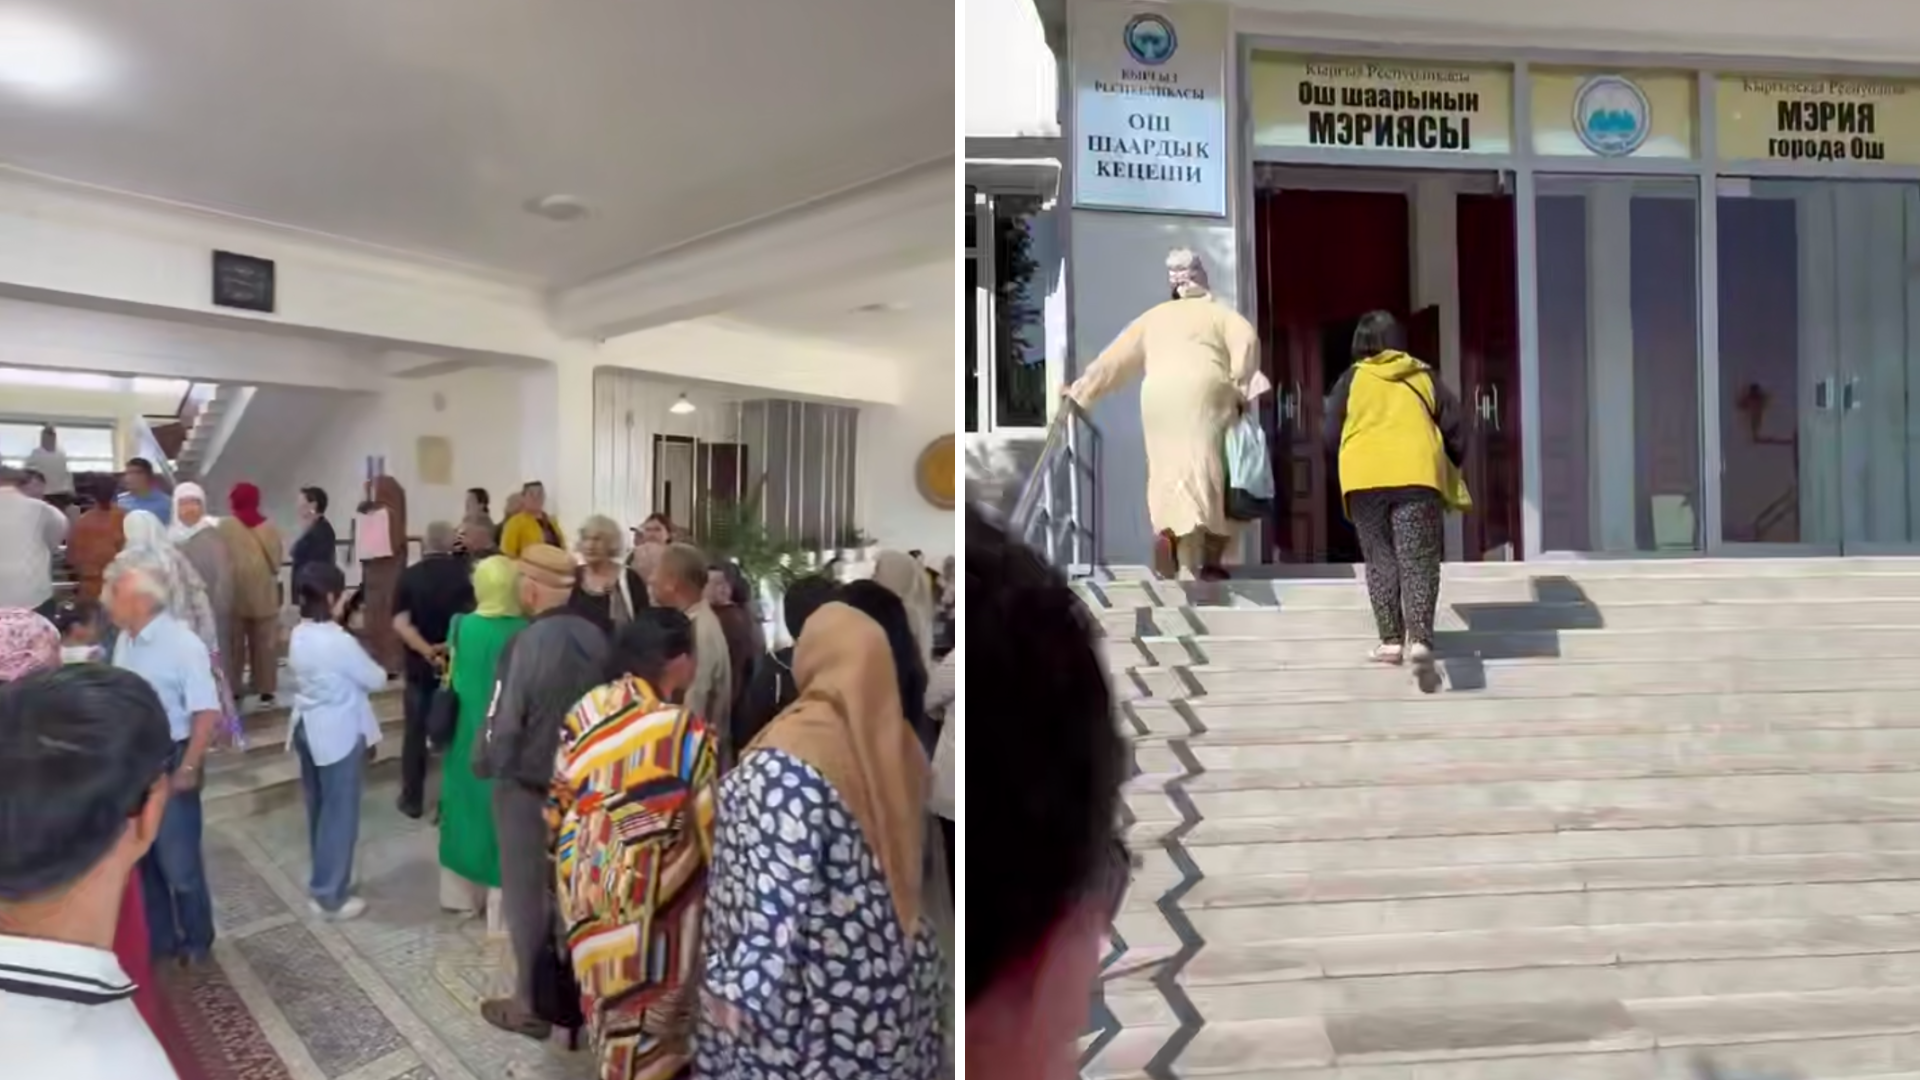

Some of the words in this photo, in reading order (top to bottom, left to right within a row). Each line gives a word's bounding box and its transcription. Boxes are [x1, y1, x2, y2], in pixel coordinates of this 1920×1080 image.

[1299, 81, 1335, 106] Ош
[1341, 85, 1479, 112] шаарынын
[1128, 113, 1171, 132] ОШ
[1309, 111, 1470, 149] МЭРИЯСЫ
[1777, 100, 1875, 133] МЭРИЯ
[1088, 135, 1209, 158] ШААРДЫК
[1769, 137, 1845, 161] города
[1851, 137, 1885, 159] Ош
